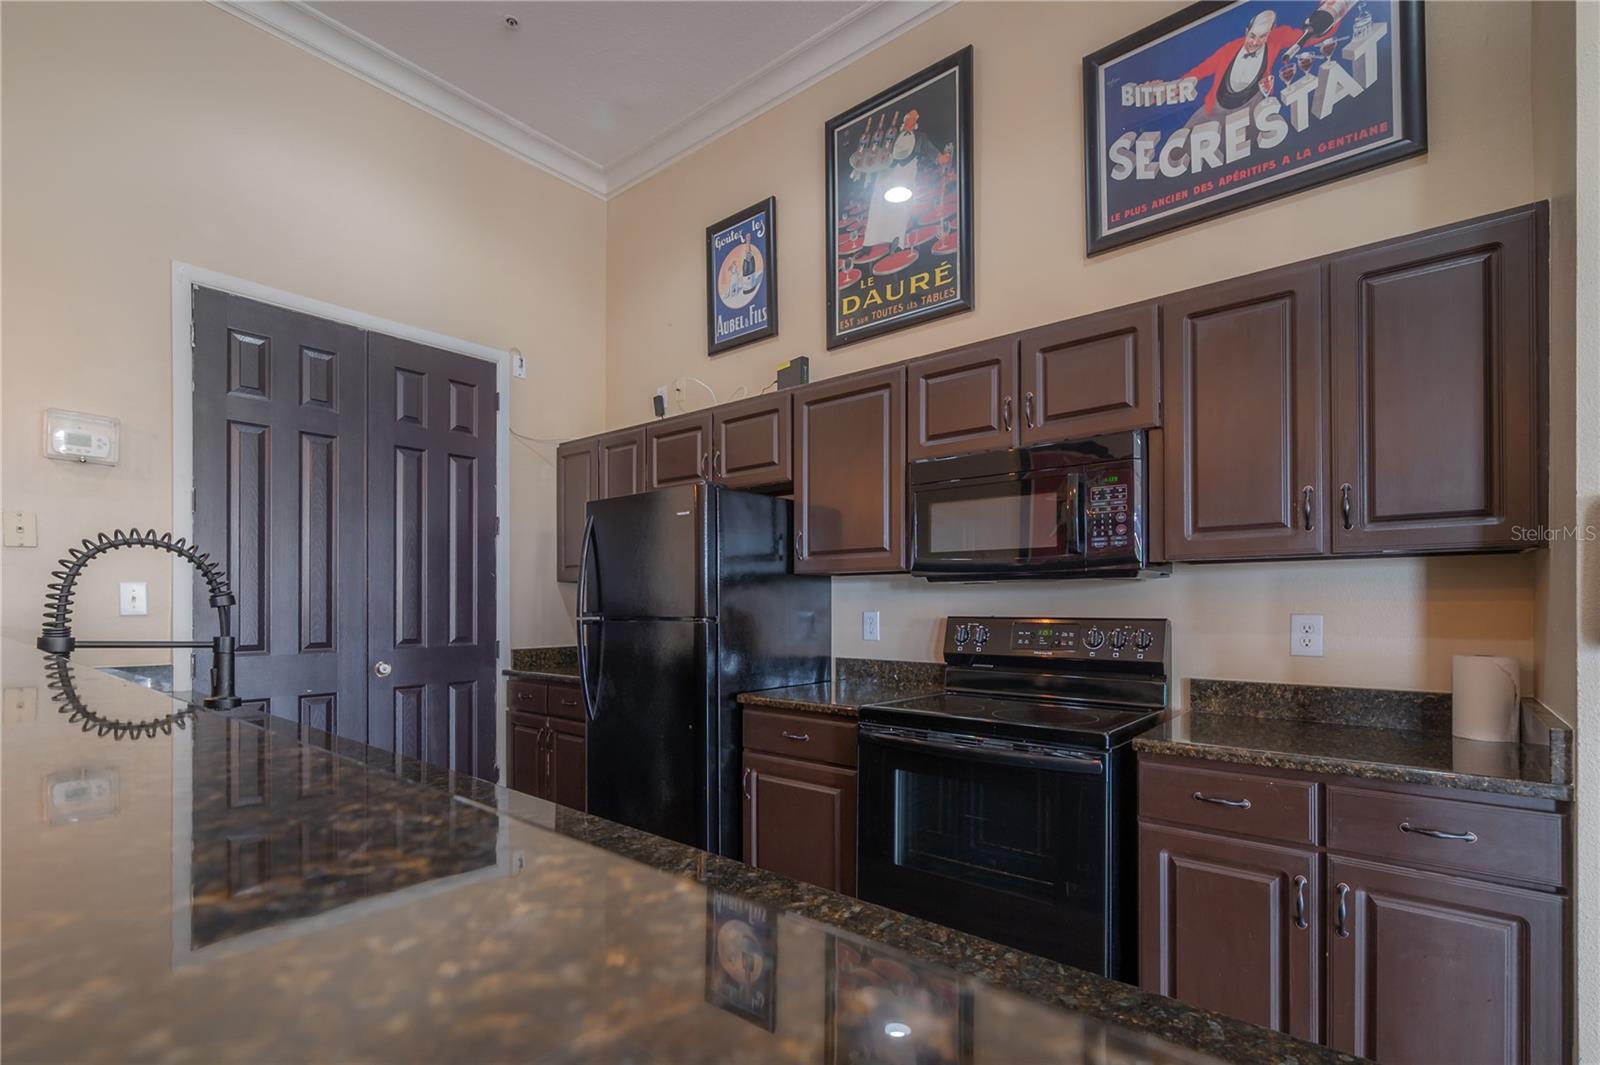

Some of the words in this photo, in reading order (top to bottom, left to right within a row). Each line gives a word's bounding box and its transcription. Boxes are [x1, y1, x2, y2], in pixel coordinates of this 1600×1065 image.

[1108, 22, 1387, 181] SECRESTAT
[1121, 76, 1198, 108] BITTER
[1111, 213, 1121, 223] LE
[1124, 203, 1148, 218] PLUS
[1151, 189, 1188, 209] ANCIEN
[1193, 180, 1214, 195] DES
[1296, 148, 1312, 161] LA
[1318, 121, 1389, 154] GENTIANE
[842, 261, 953, 316] DAURÉ
[860, 276, 875, 289] LE
[716, 314, 745, 337] AUBEL
[749, 304, 768, 326] FILS
[840, 318, 854, 330] EST
[872, 303, 904, 320] TOUTES
[921, 288, 956, 305] TABLES
